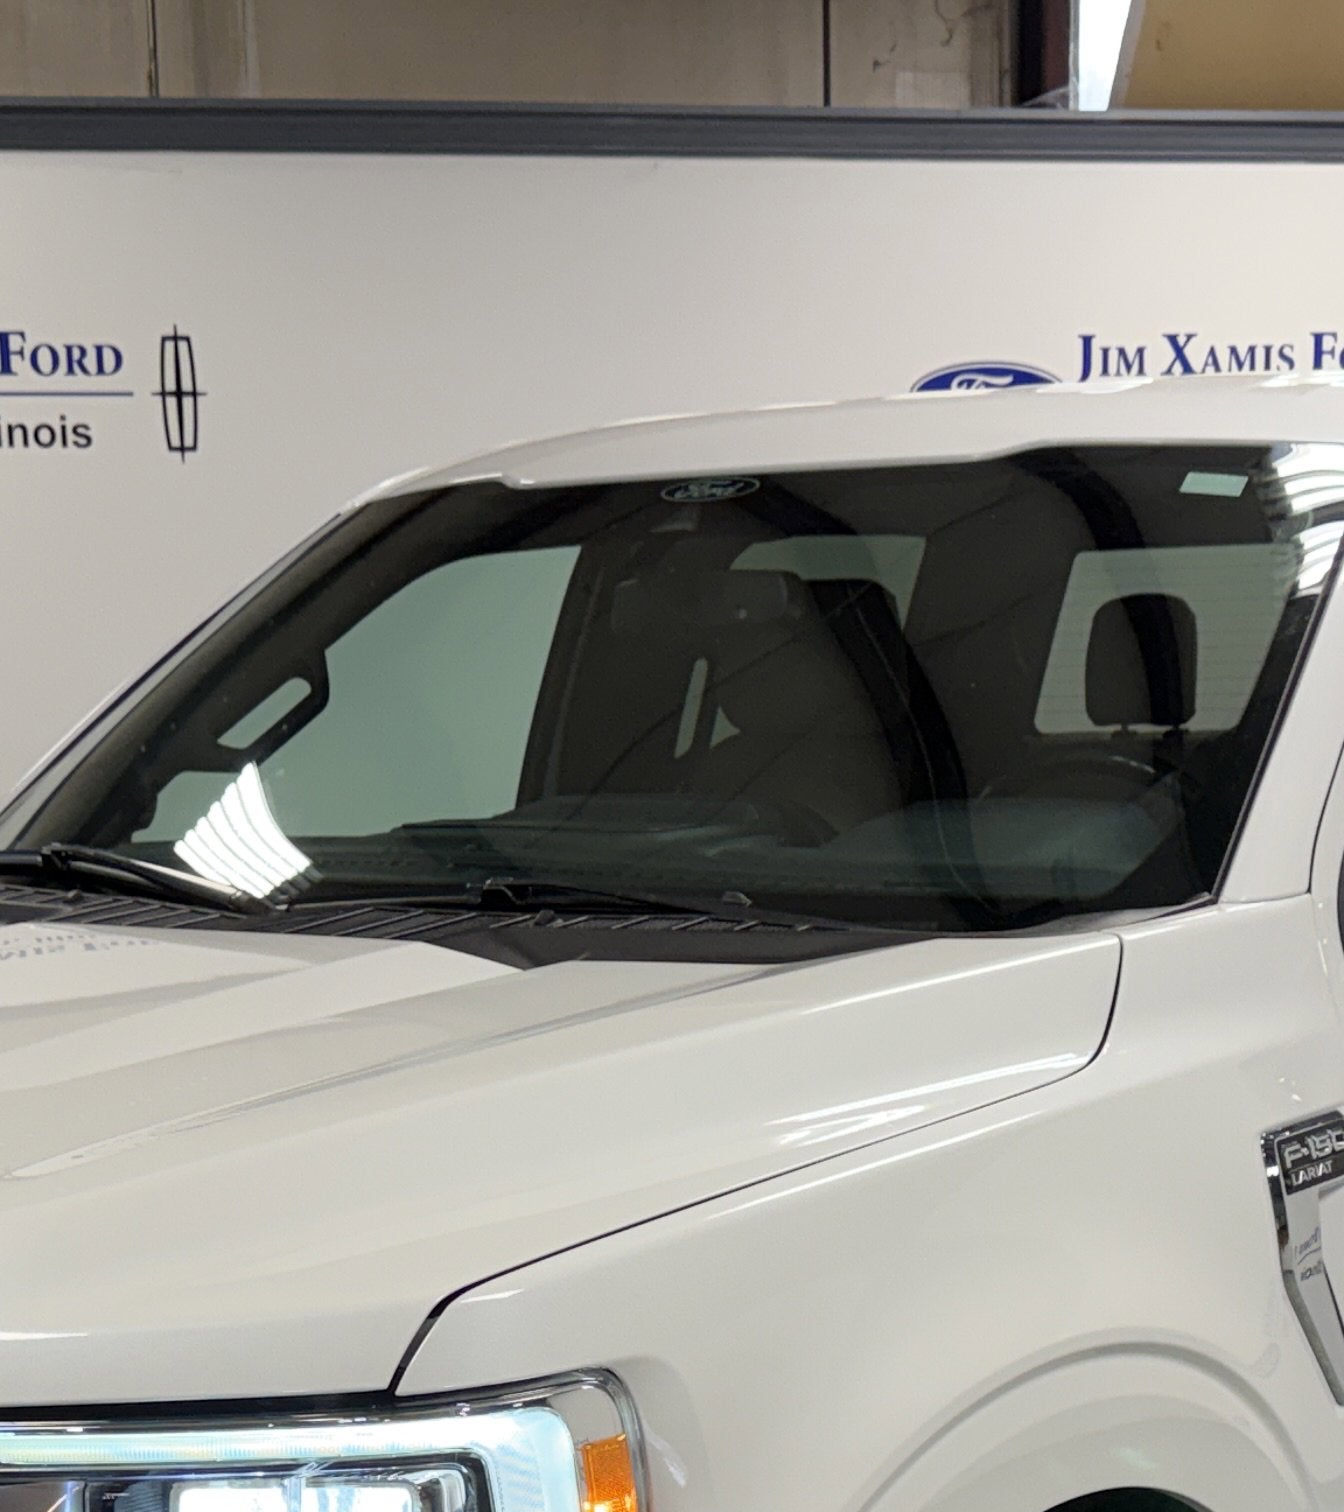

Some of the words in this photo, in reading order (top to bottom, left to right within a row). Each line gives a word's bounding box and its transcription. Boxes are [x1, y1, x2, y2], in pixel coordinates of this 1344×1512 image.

[1077, 334, 1147, 382] JIM
[1160, 333, 1296, 376] XAMIS
[1290, 1160, 1333, 1186] LARIAT
